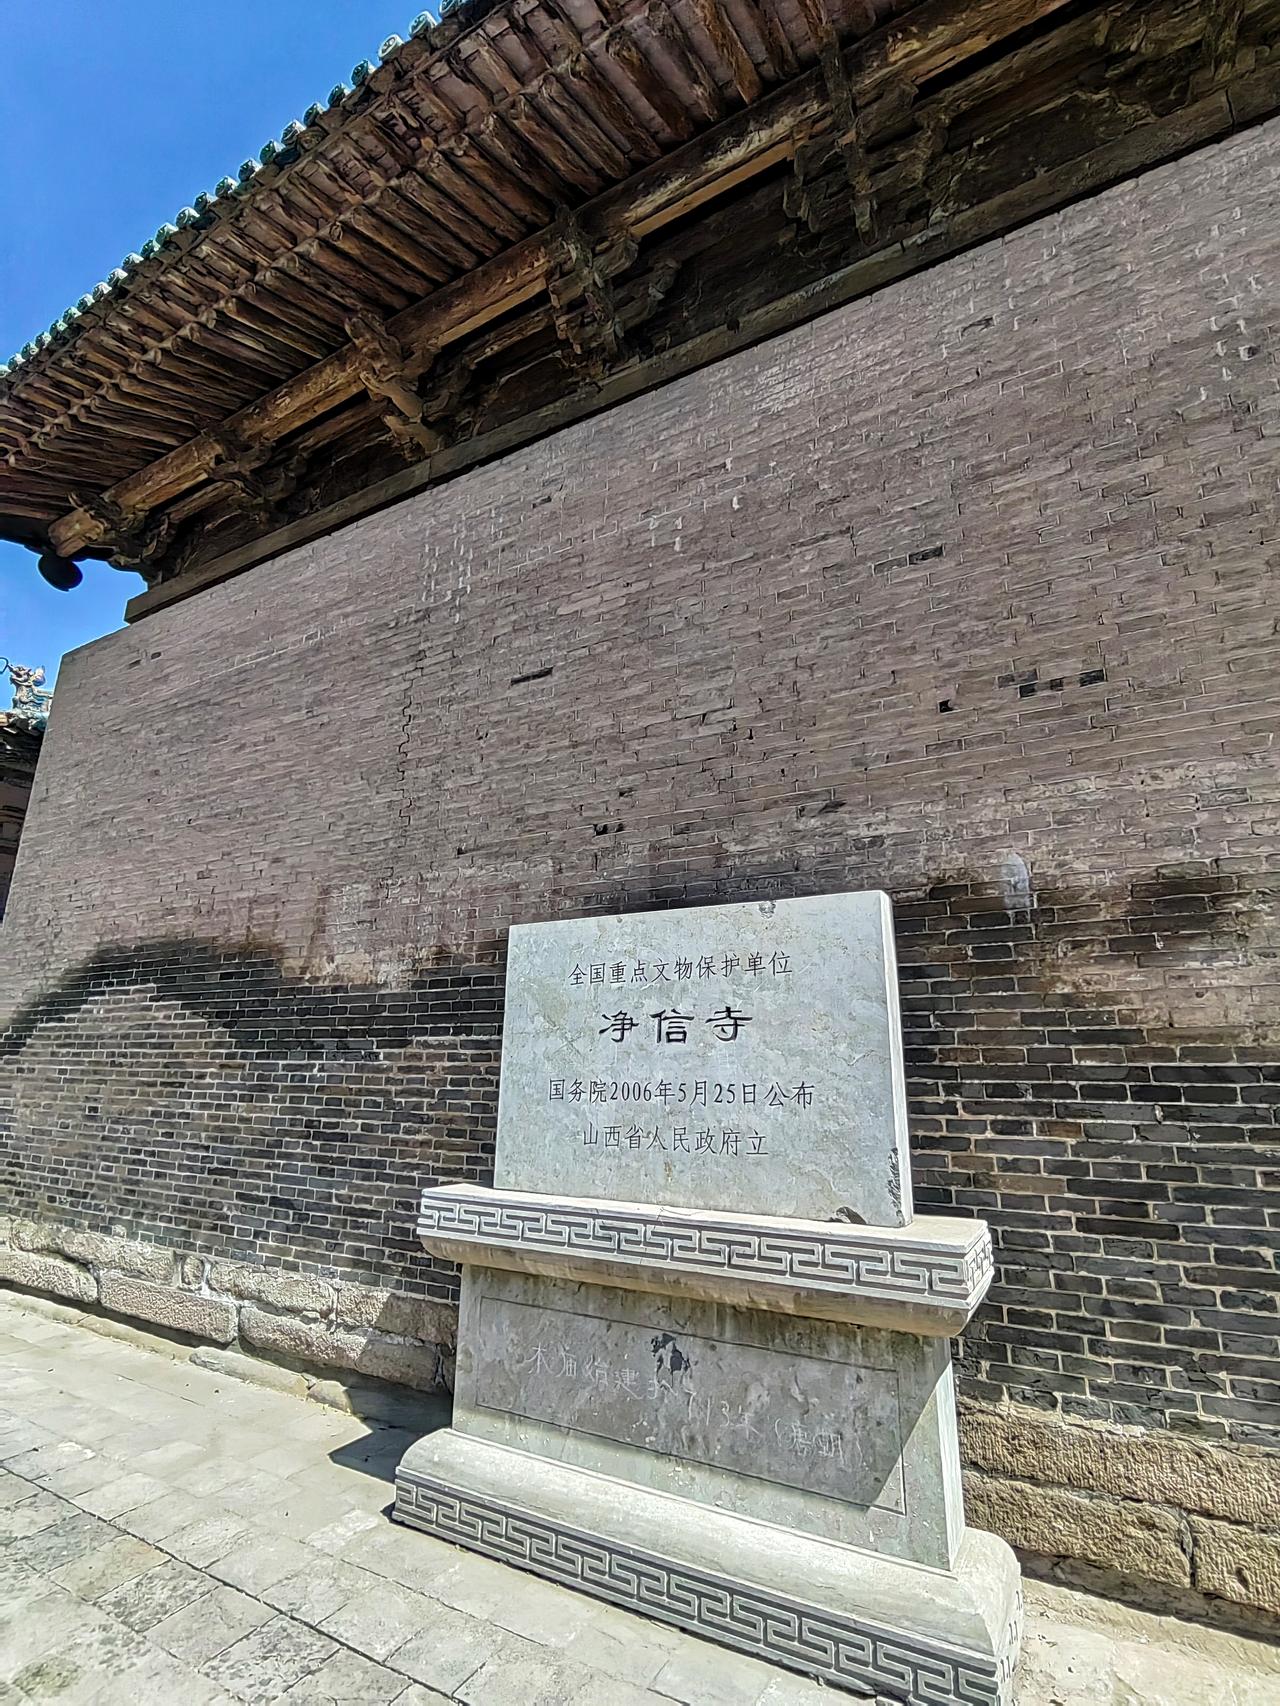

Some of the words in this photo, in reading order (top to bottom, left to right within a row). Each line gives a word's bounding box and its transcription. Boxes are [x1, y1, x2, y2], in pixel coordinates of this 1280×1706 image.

[567, 950, 793, 986] 全国重点文物保护单位
[598, 1006, 754, 1044] 净信寺
[548, 1078, 815, 1110] 国务院2006年5月25日公布
[583, 1122, 769, 1157] 山西省人民政府立
